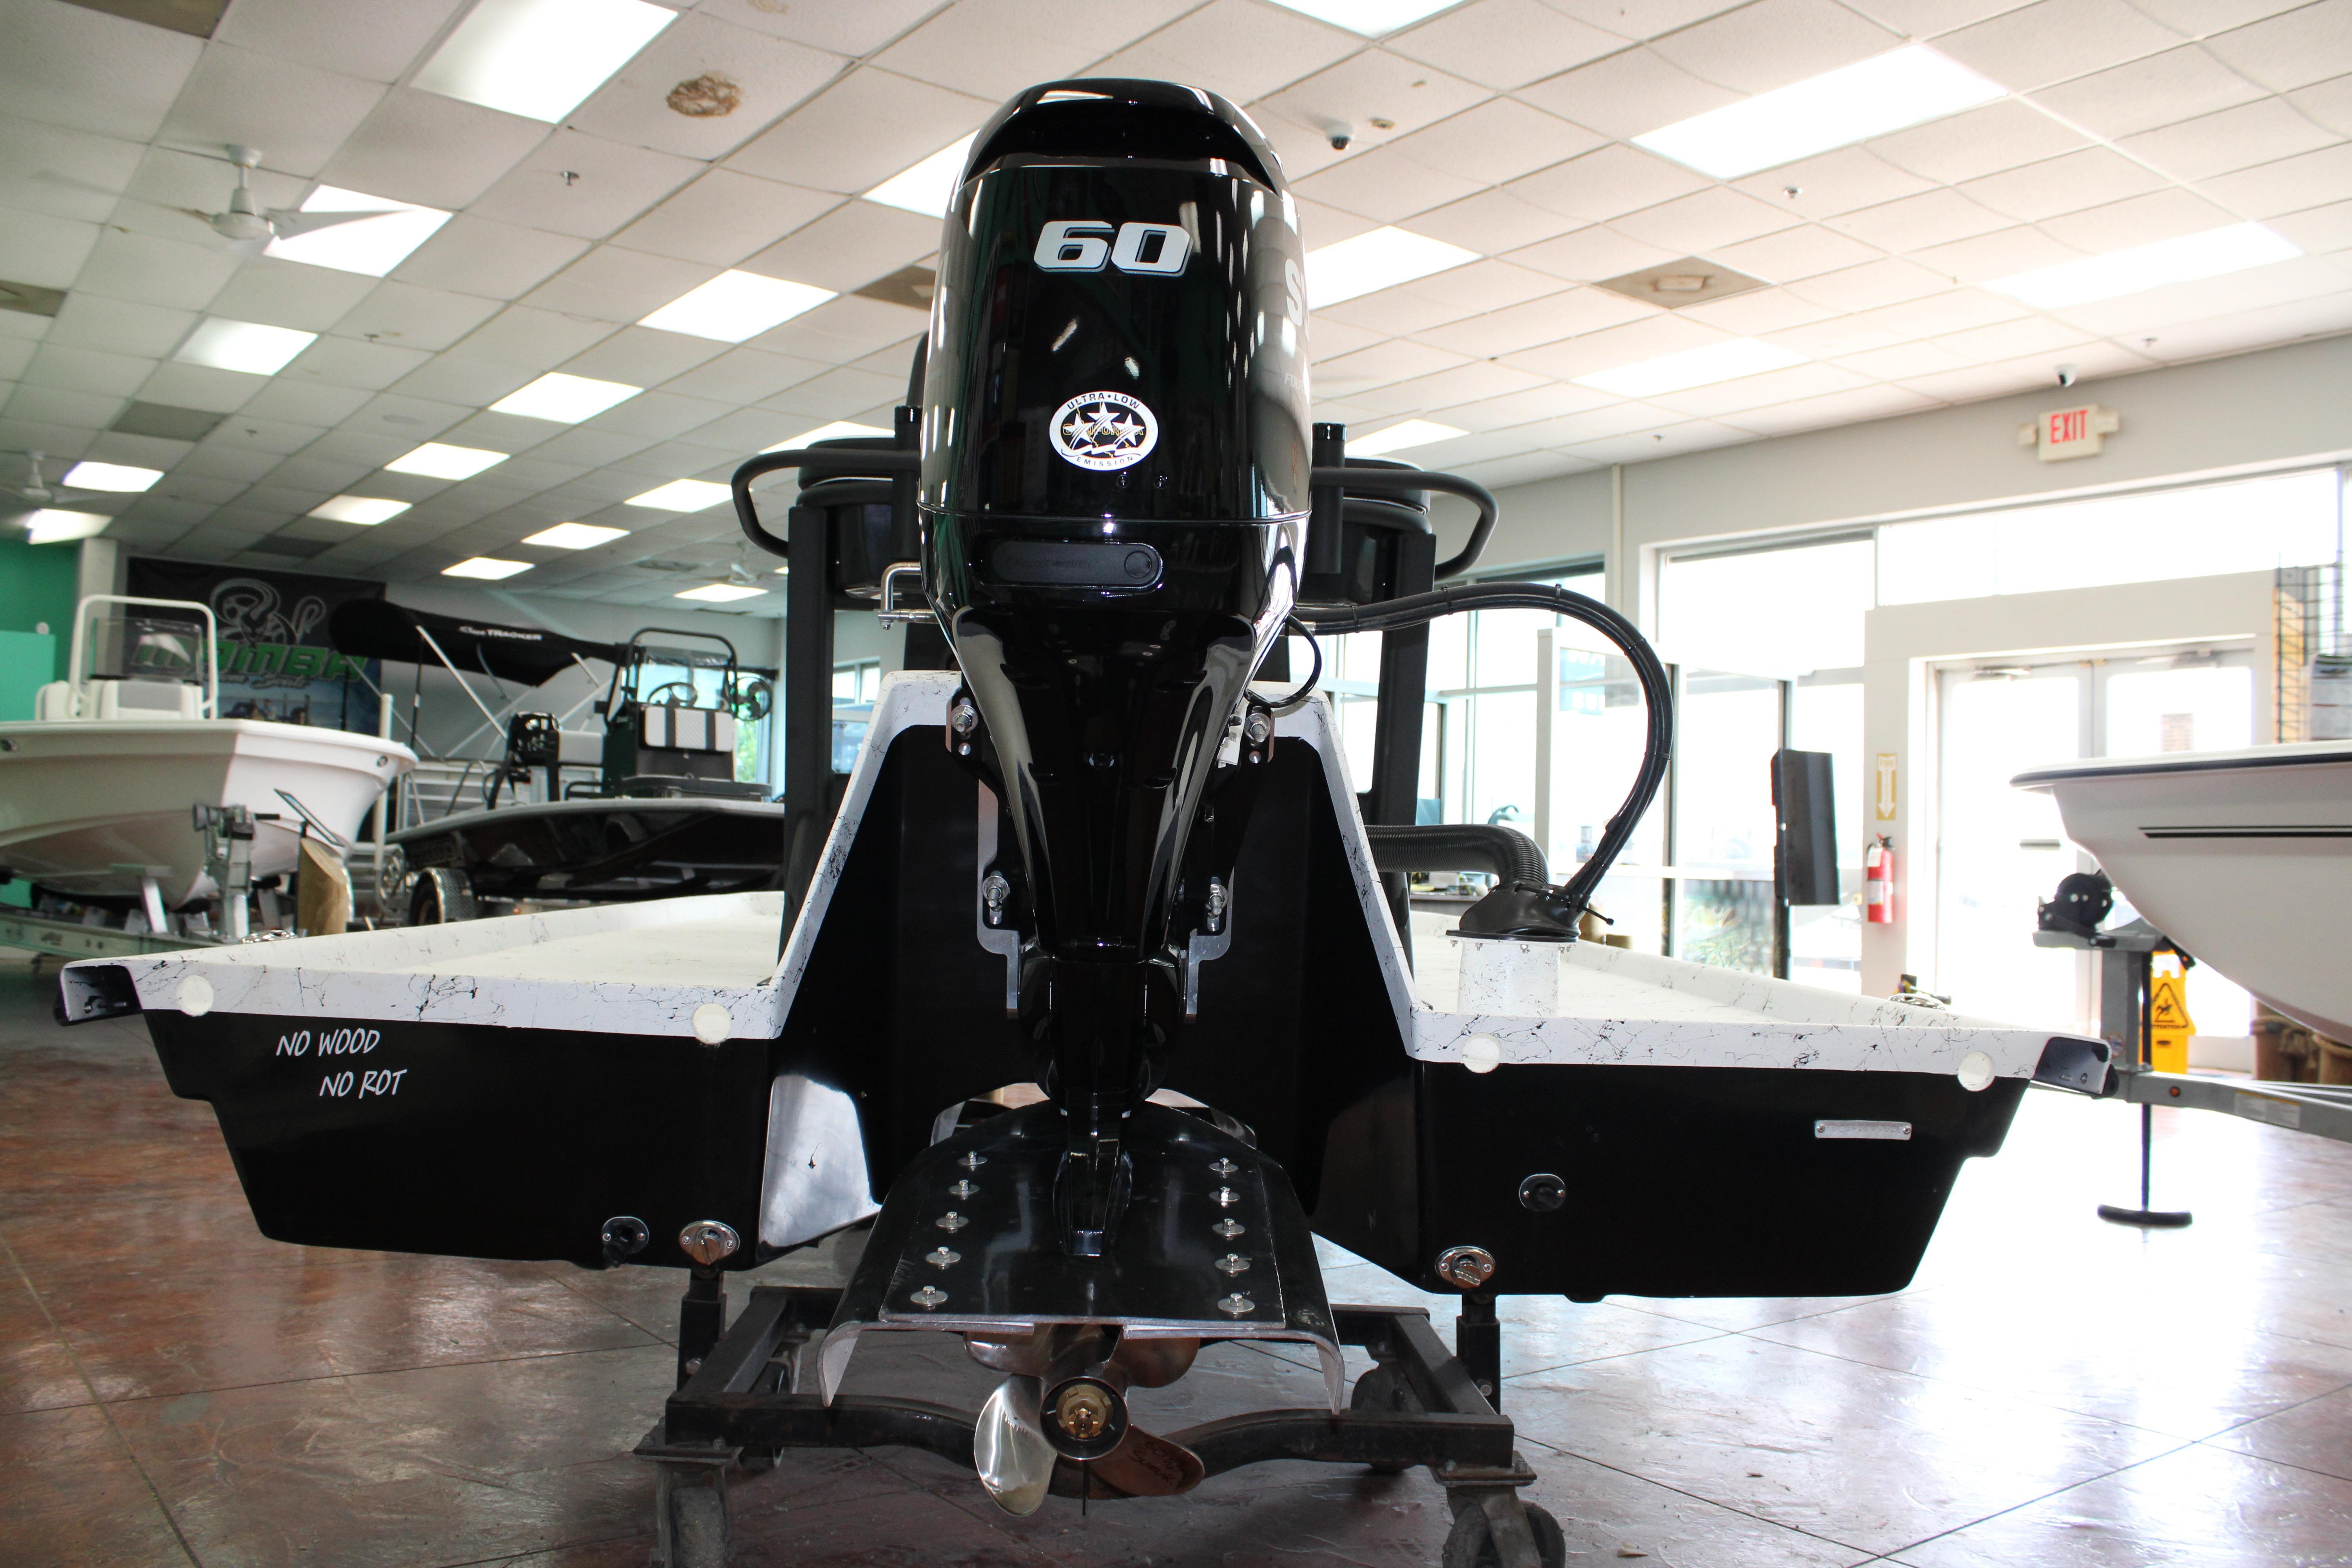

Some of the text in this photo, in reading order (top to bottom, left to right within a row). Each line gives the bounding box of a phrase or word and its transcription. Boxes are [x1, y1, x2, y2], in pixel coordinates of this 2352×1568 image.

[1034, 221, 1193, 277] 60
[1067, 392, 1140, 410] ULTRA LOW
[2051, 410, 2088, 444] EXIT
[1077, 456, 1133, 466] EMISSION
[276, 1027, 380, 1057] NO WOOD
[319, 1069, 408, 1100] NO ROT
